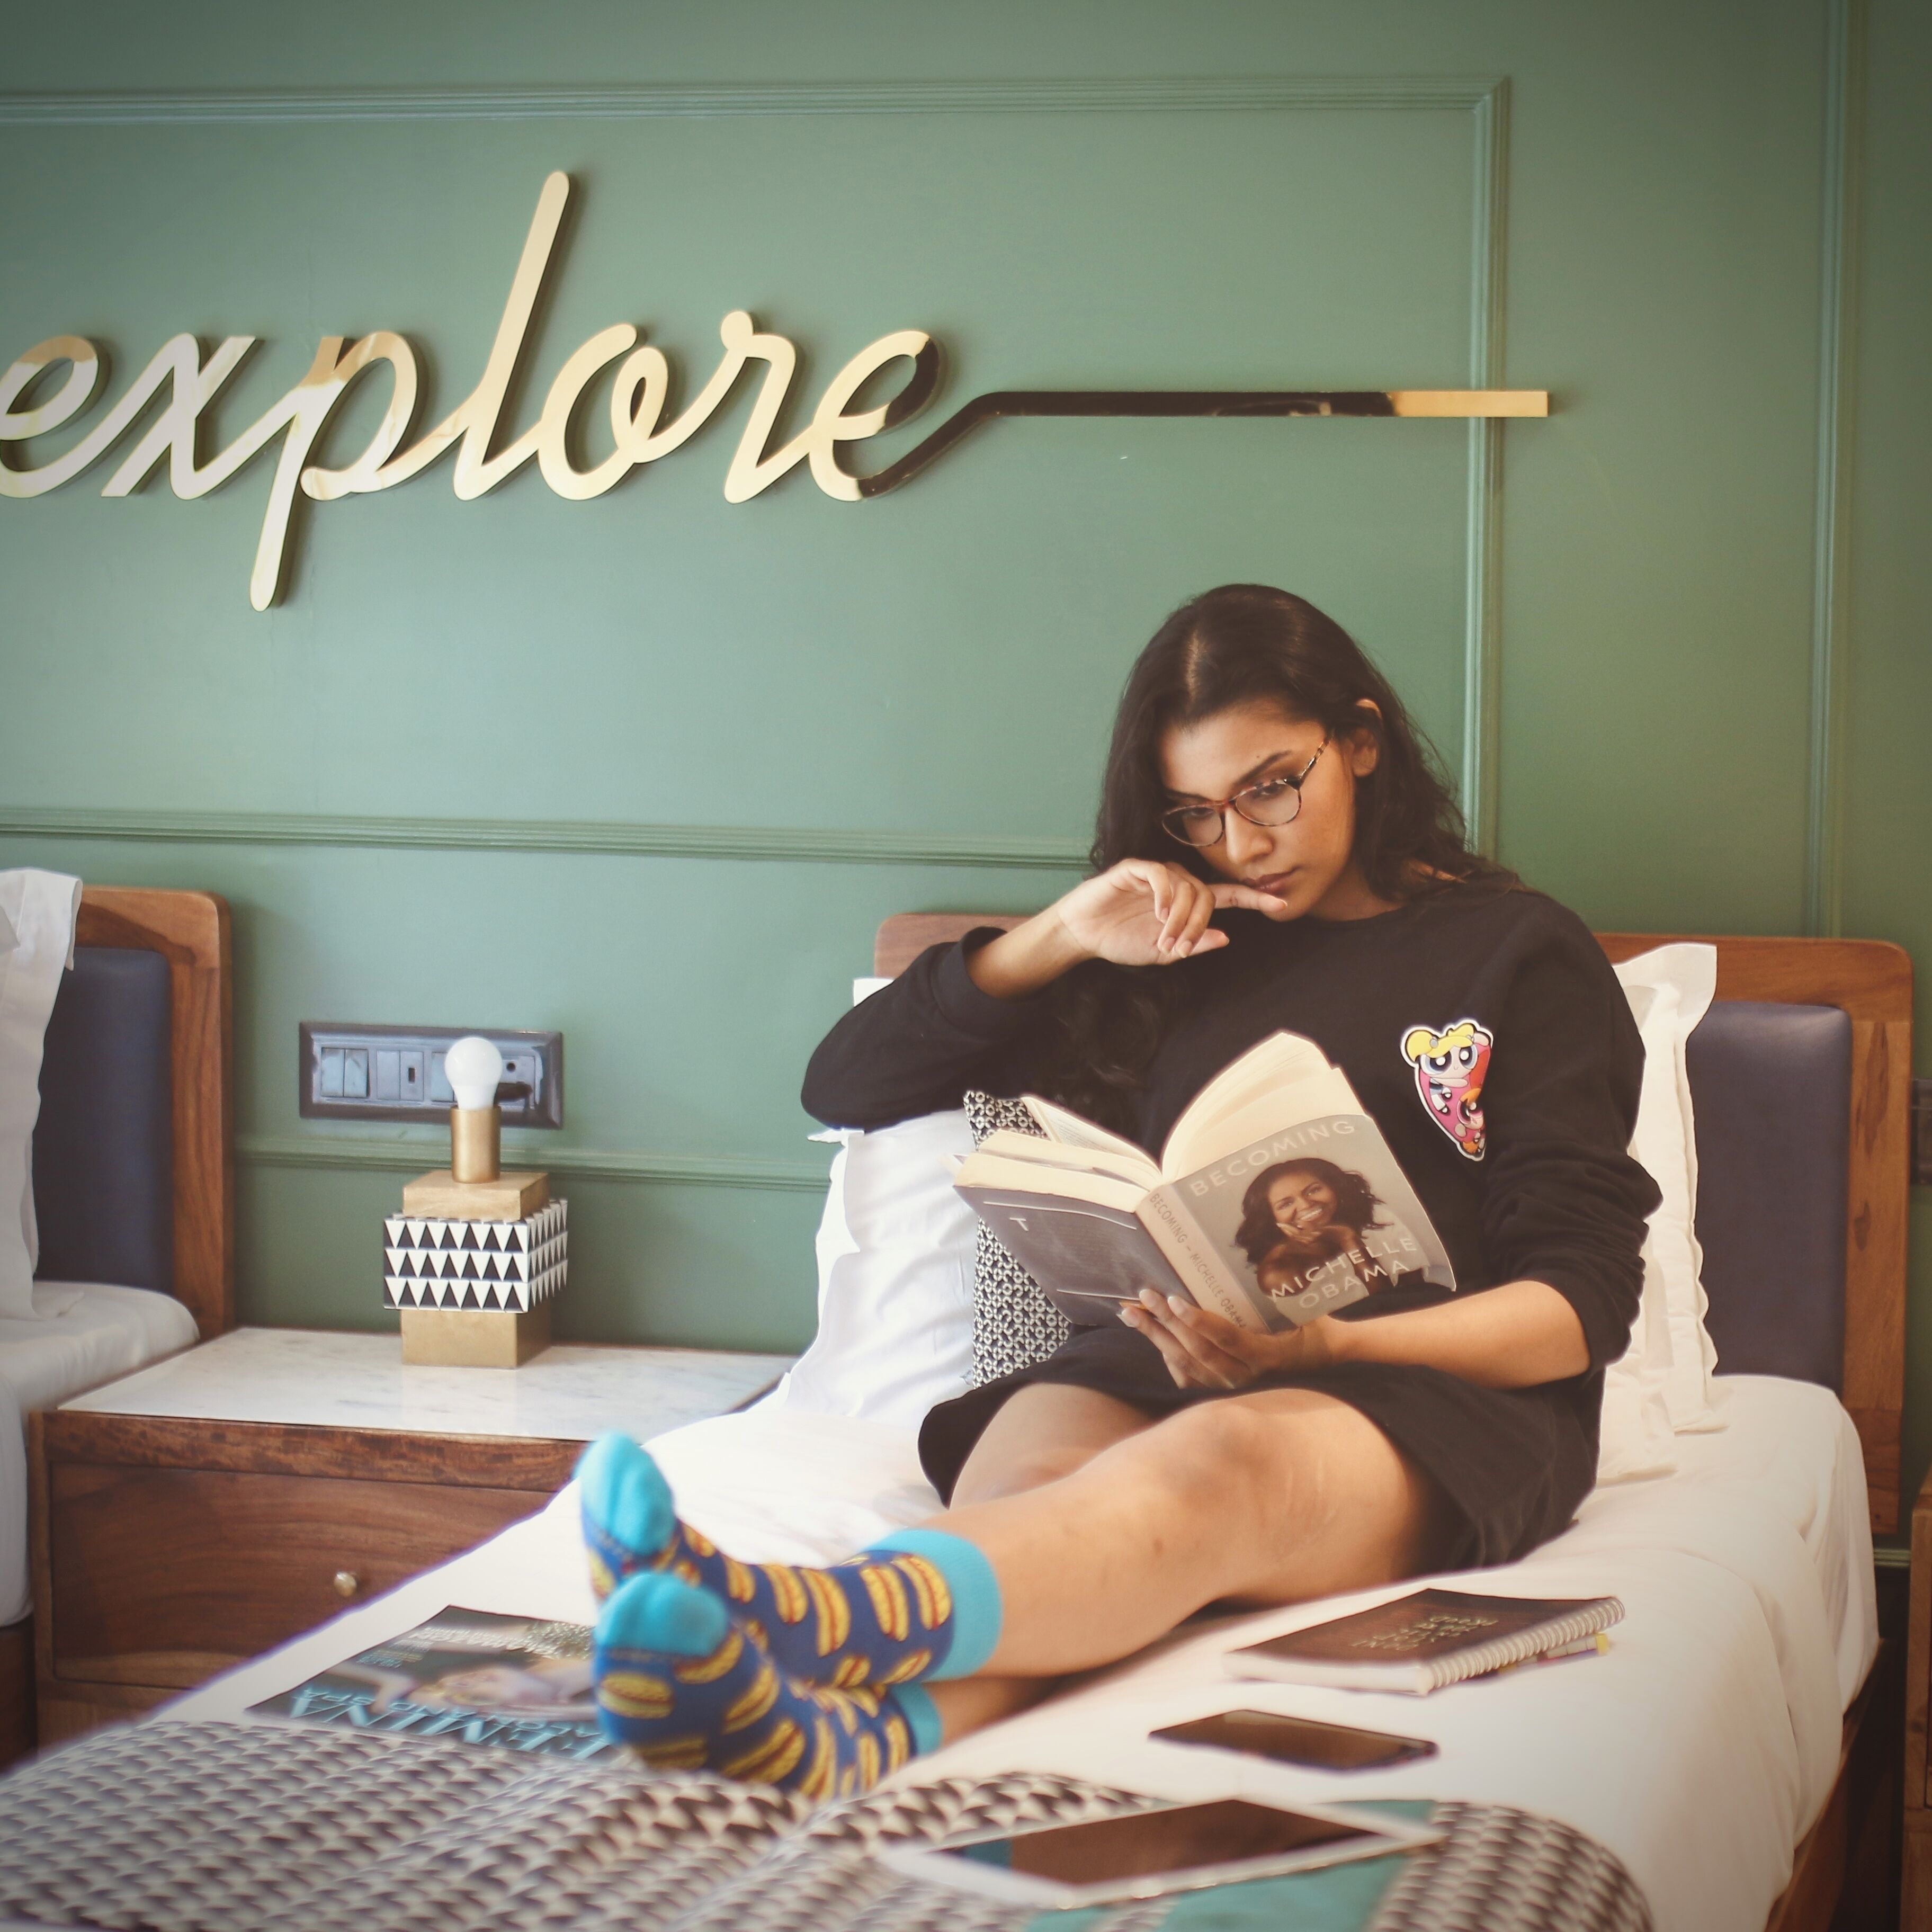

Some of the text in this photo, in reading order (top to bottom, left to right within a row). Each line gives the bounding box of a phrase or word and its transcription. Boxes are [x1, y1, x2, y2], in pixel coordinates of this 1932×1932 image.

[0, 169, 945, 612] explore
[1189, 1121, 1355, 1197] BECOMING
[1149, 1193, 1188, 1244] BECOMING
[1190, 1253, 1224, 1298] MICHELLE
[1271, 1238, 1417, 1302] MICHELLE
[1300, 1259, 1410, 1309] OBAMA
[288, 1697, 611, 1761] FEMINA
[303, 1689, 605, 1742] ALON AND SPA
